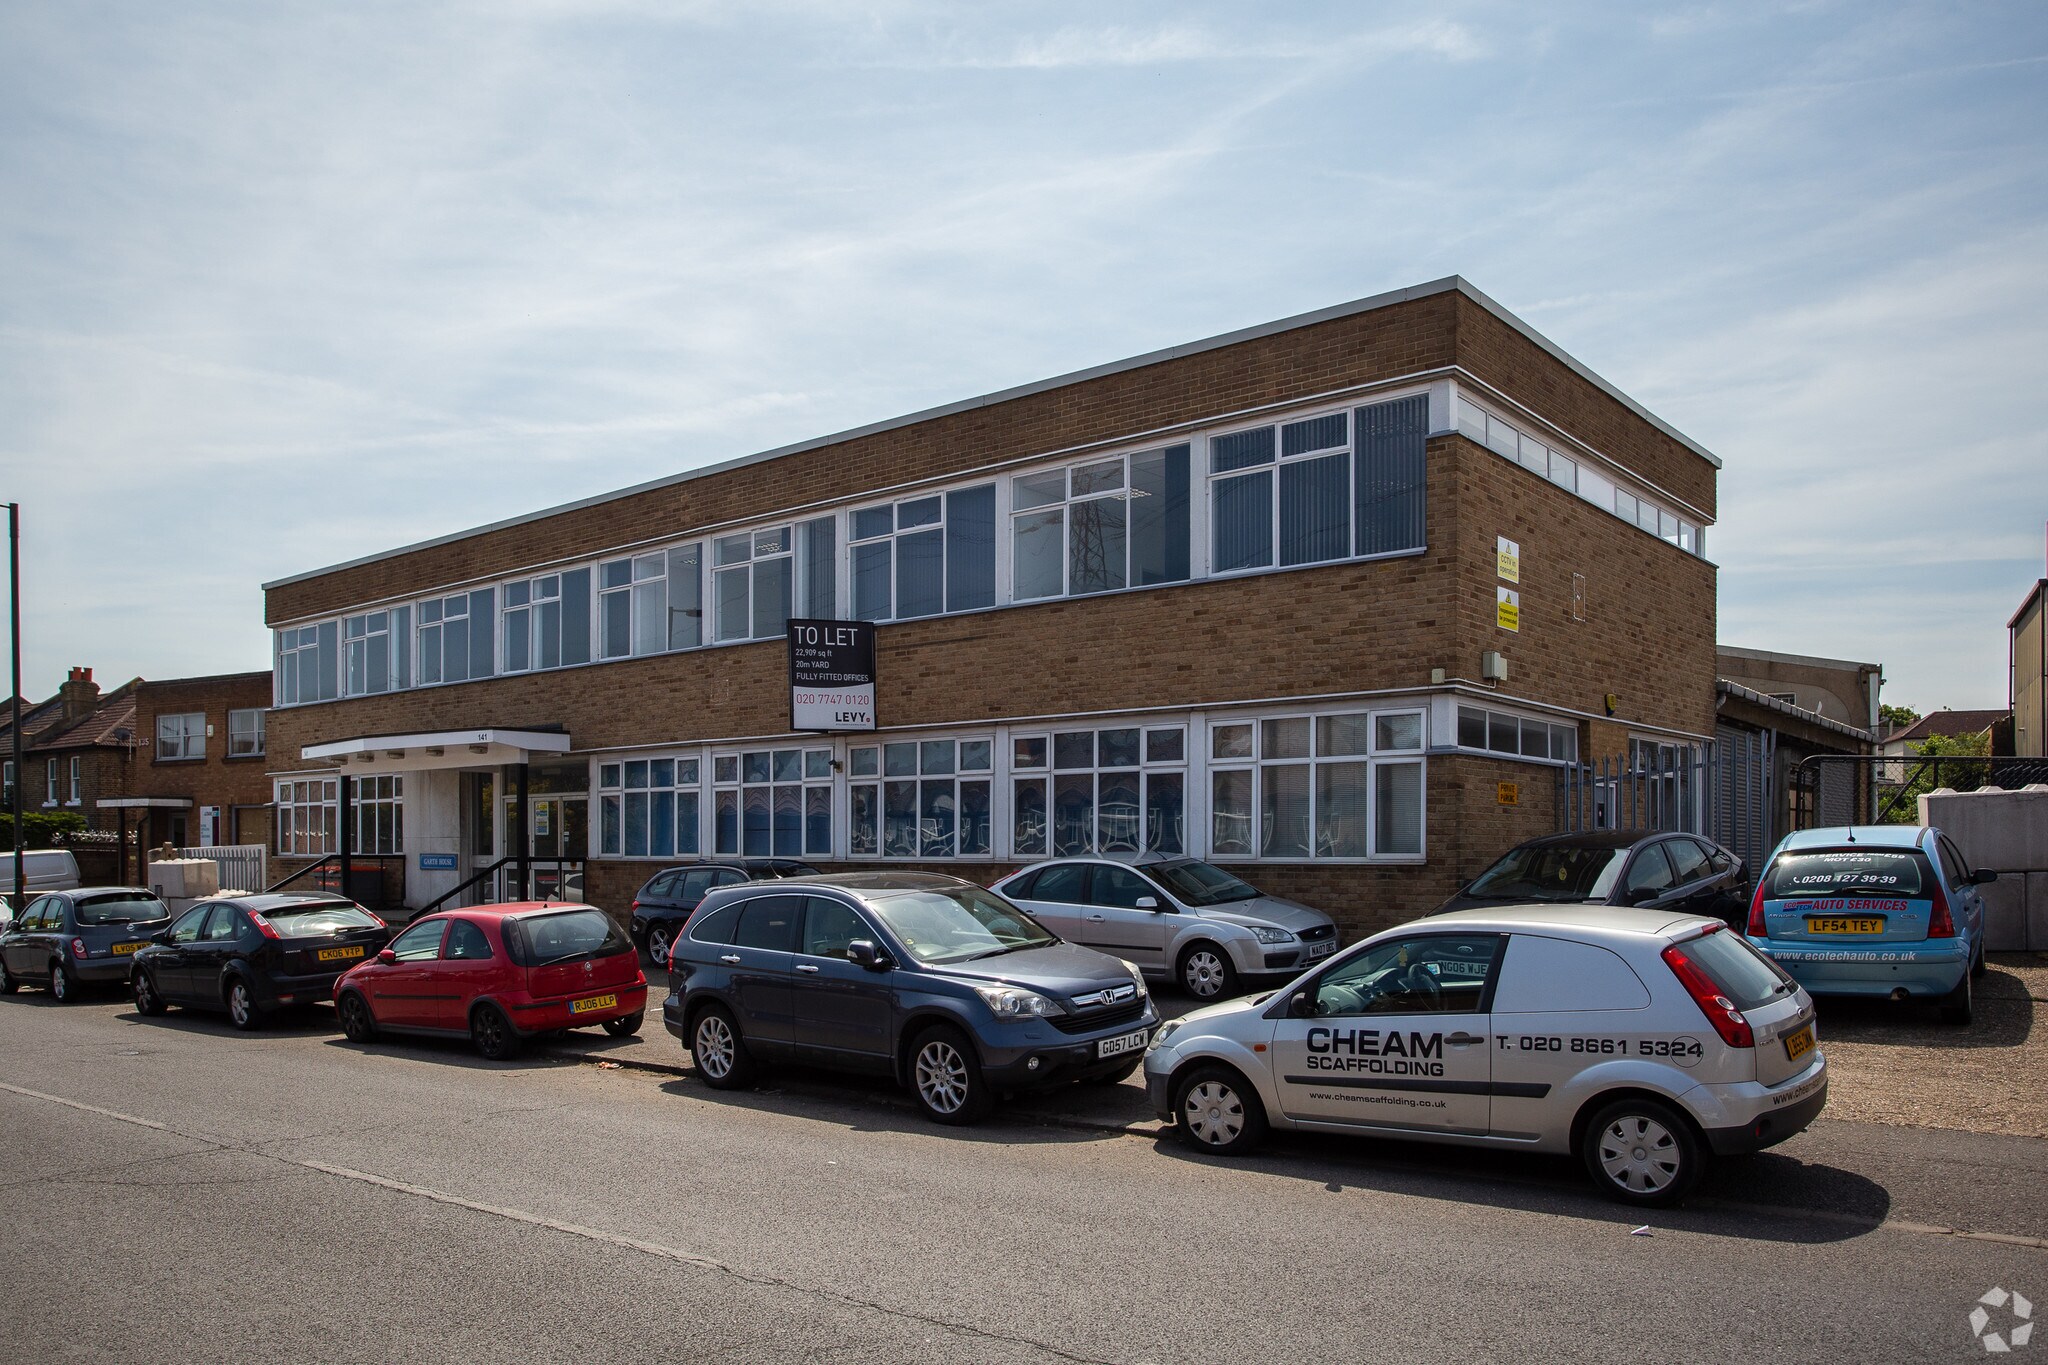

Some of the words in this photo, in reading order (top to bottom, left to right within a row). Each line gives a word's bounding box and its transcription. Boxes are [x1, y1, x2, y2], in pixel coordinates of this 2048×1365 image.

[1500, 565, 1517, 577] operation
[794, 625, 818, 645] TO
[825, 627, 858, 646] LET
[795, 648, 817, 657] 22,909
[818, 650, 826, 658] sq
[827, 649, 833, 657] ft
[796, 660, 810, 668] 20m
[811, 661, 830, 669] YARD
[796, 672, 818, 680] FULLY
[819, 672, 843, 681] FITTED
[843, 673, 869, 682] OFFICES
[796, 693, 815, 704] 020
[818, 694, 842, 705] 7747
[845, 694, 870, 705] 0120
[478, 733, 488, 741] 141
[423, 858, 438, 866] GARTH
[438, 858, 453, 866] HOUSE
[1801, 875, 1832, 884] 0208
[1835, 874, 1859, 883] 127
[1812, 900, 1845, 911] AUTO
[1847, 899, 1908, 911] SERVICES
[1813, 920, 1848, 932] LF54
[1851, 920, 1878, 932] TEY
[115, 945, 136, 953] LV05
[321, 950, 343, 959] CK06
[344, 947, 361, 957] VTP
[1774, 951, 1916, 961] www.ecotechauto.co.uk
[1440, 961, 1465, 974] NG06
[1467, 963, 1487, 975] WJE
[574, 1000, 598, 1012] RJ06
[599, 995, 615, 1007] LLP
[1102, 1038, 1126, 1055] GD57
[1128, 1032, 1145, 1049] LCW
[1307, 1027, 1443, 1059] CHEAM
[1496, 1035, 1511, 1050] T.
[1520, 1036, 1562, 1052] 020
[1570, 1038, 1627, 1055] 8661
[1639, 1040, 1704, 1058] 5324
[1306, 1055, 1444, 1077] SCAFFOLDING
[1309, 1092, 1447, 1109] www.cheamscaffolding.co.uk
